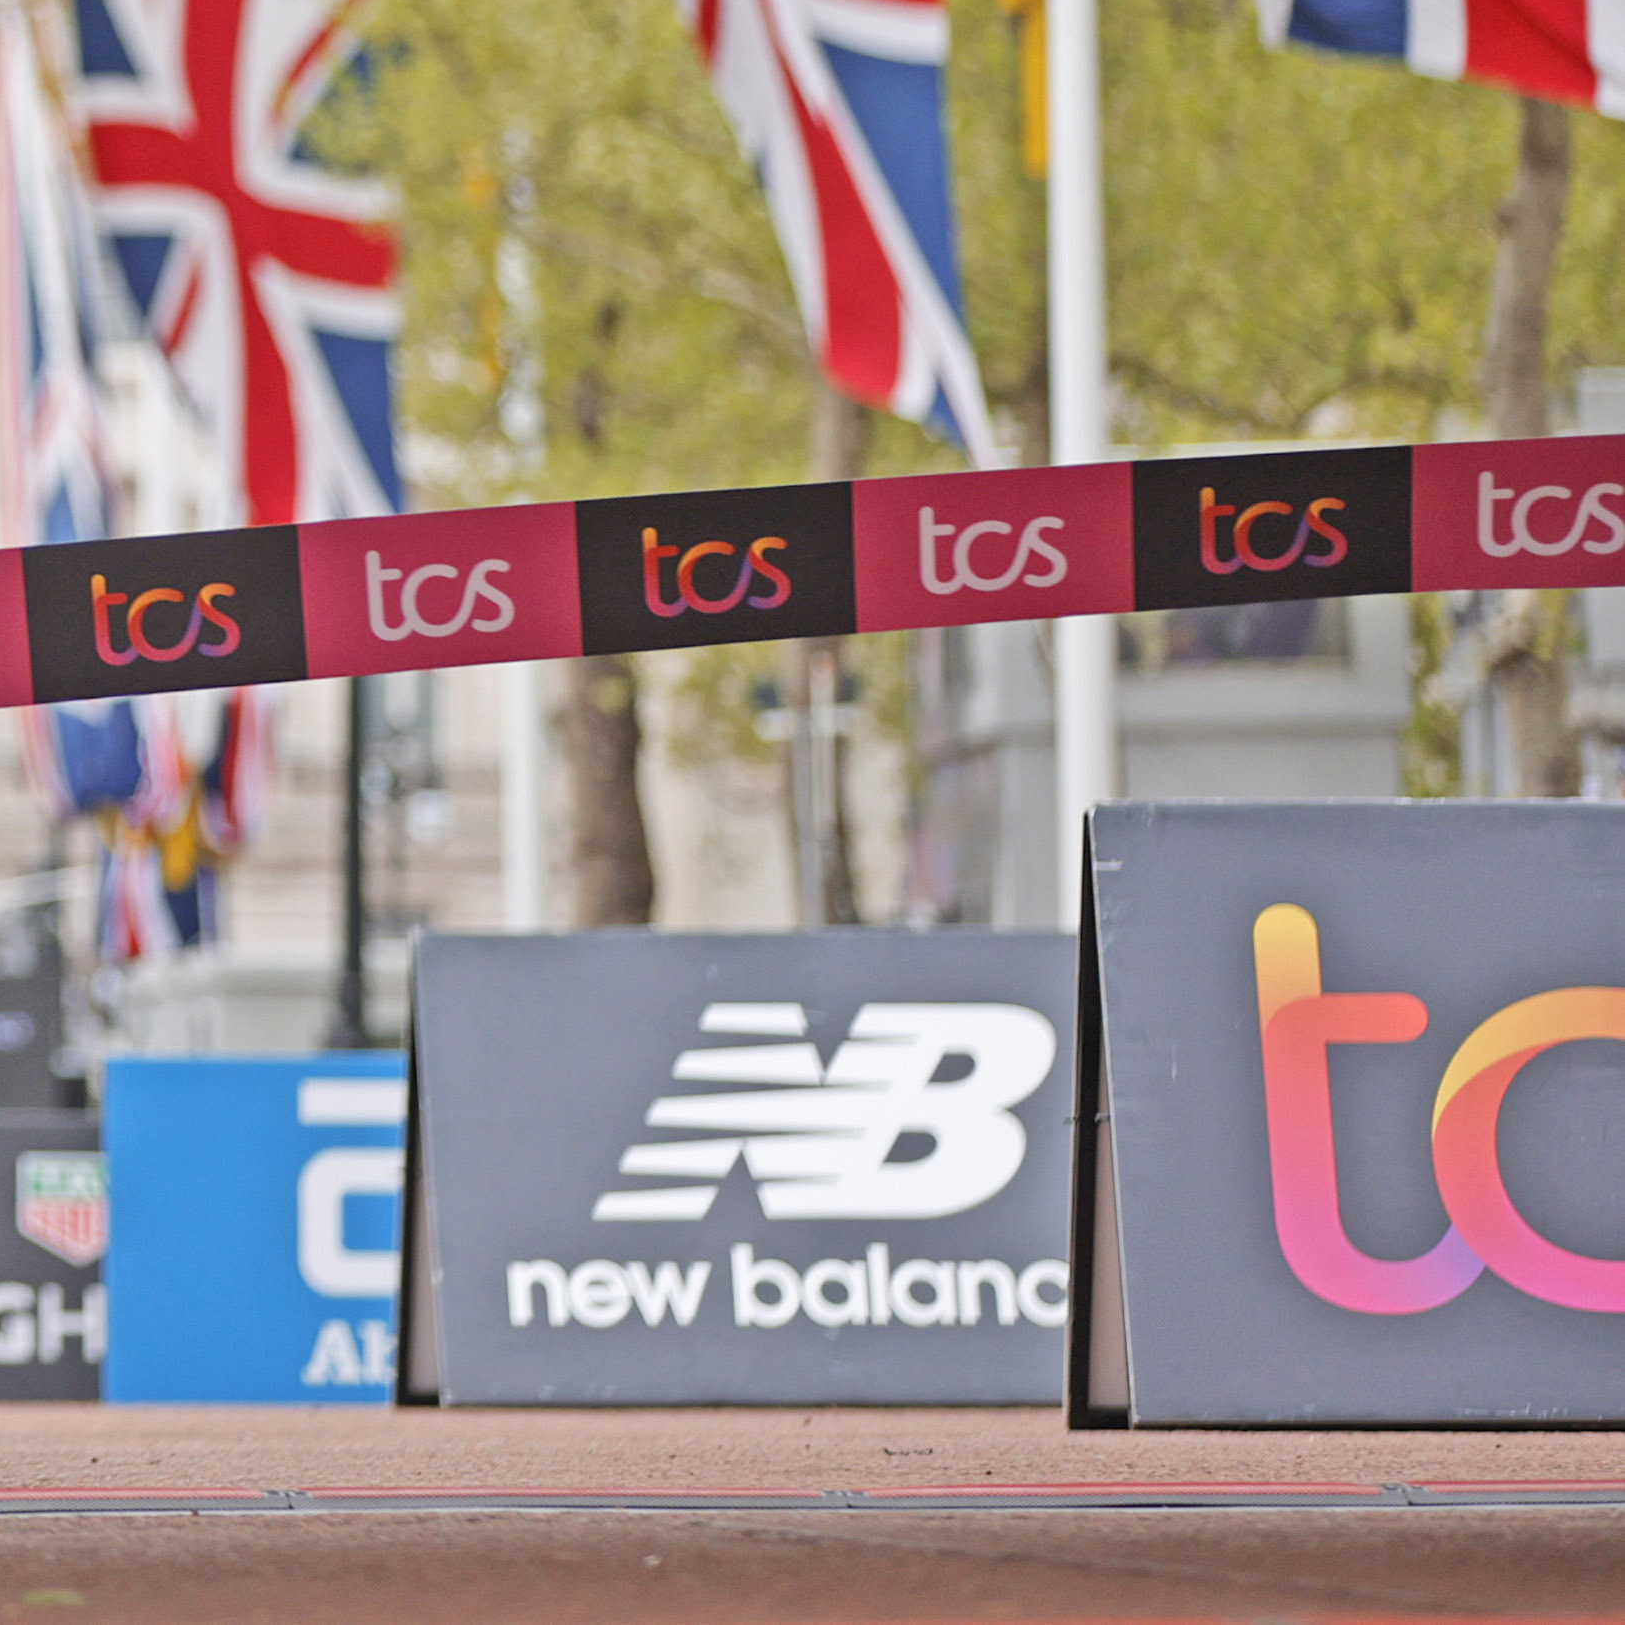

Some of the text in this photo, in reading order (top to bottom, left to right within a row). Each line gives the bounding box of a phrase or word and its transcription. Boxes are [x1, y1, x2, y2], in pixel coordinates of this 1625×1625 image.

[90, 574, 241, 666] tcs
[365, 550, 515, 642] tcs
[641, 526, 792, 617] tcs
[918, 506, 1068, 595] tcs
[1199, 486, 1348, 575] tcs
[1477, 471, 1625, 558] tcs
[506, 1244, 1070, 1327] new balanc
